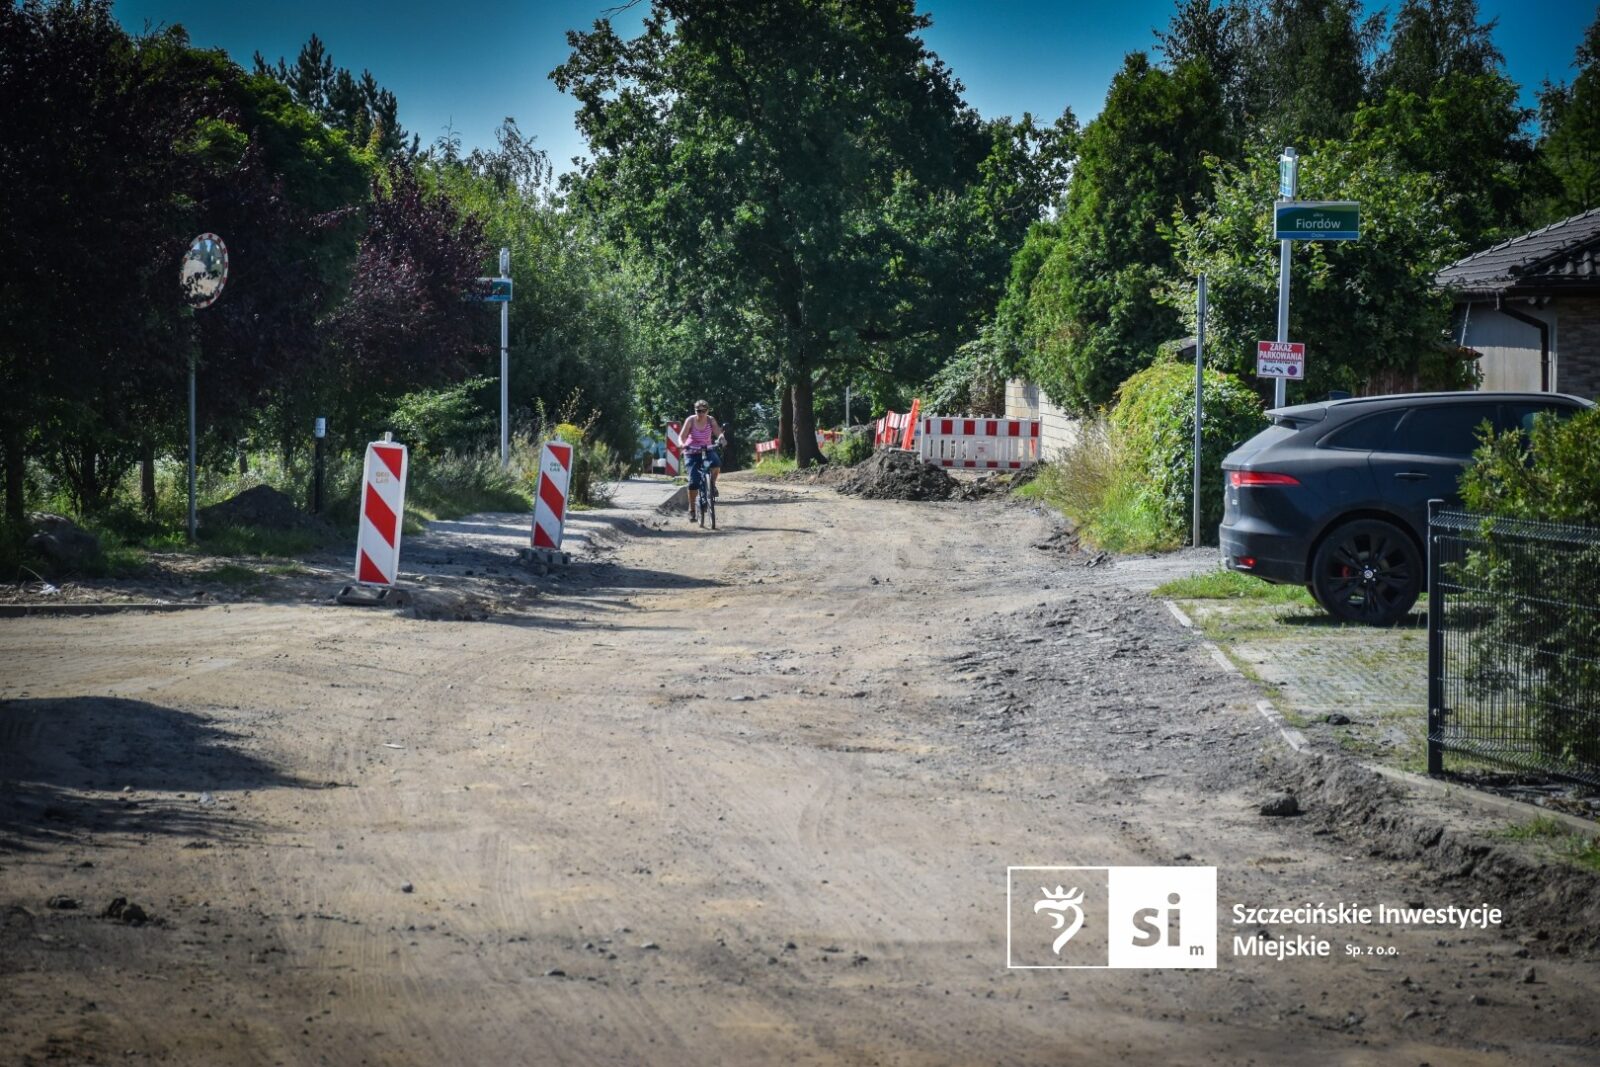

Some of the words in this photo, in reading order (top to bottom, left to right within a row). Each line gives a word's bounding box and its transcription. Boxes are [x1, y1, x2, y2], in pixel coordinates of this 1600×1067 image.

[1296, 218, 1341, 229] Fiordów
[1270, 343, 1292, 352] ZAKAZ
[1259, 351, 1303, 361] PARKOWANIA
